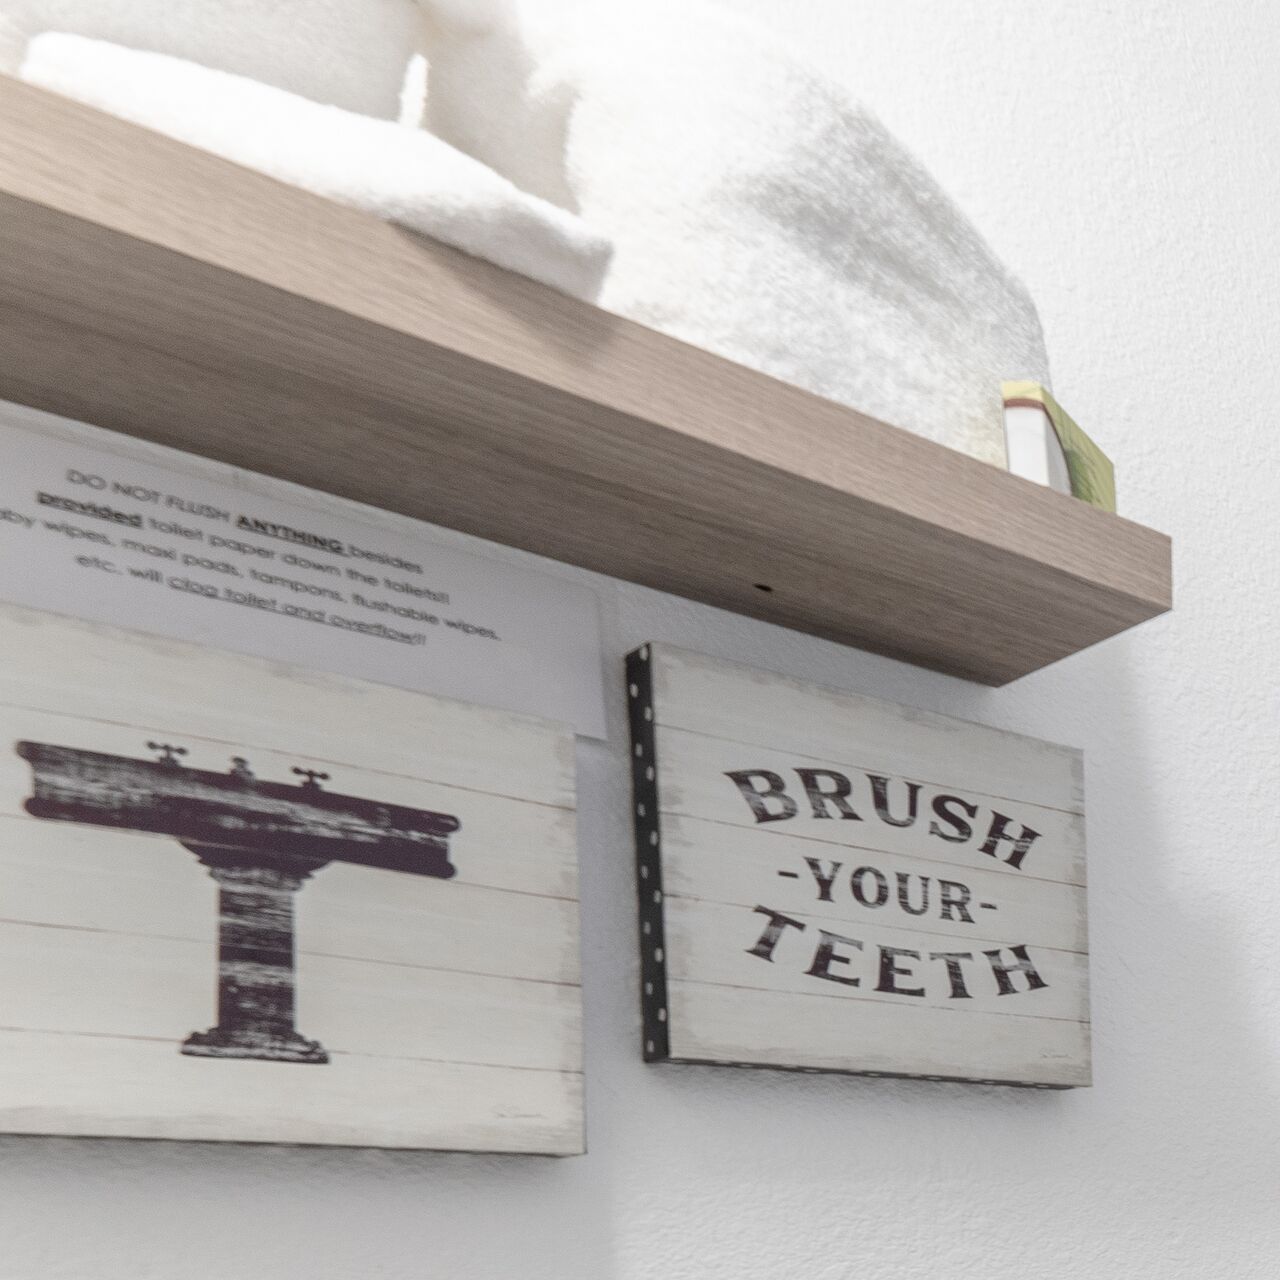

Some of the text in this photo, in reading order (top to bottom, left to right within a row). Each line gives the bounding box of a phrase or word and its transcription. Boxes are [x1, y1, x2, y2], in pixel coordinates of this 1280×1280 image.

[37, 490, 143, 530] provided
[208, 533, 275, 561] paper
[280, 552, 342, 577] down
[345, 567, 380, 587] the
[66, 468, 424, 575] DO NOT FLUSH ANYTHING besides
[128, 566, 163, 584] will
[167, 576, 218, 600] clog
[283, 600, 326, 623] and
[722, 767, 1043, 871] BRUSH
[744, 905, 1049, 999] TEETH
